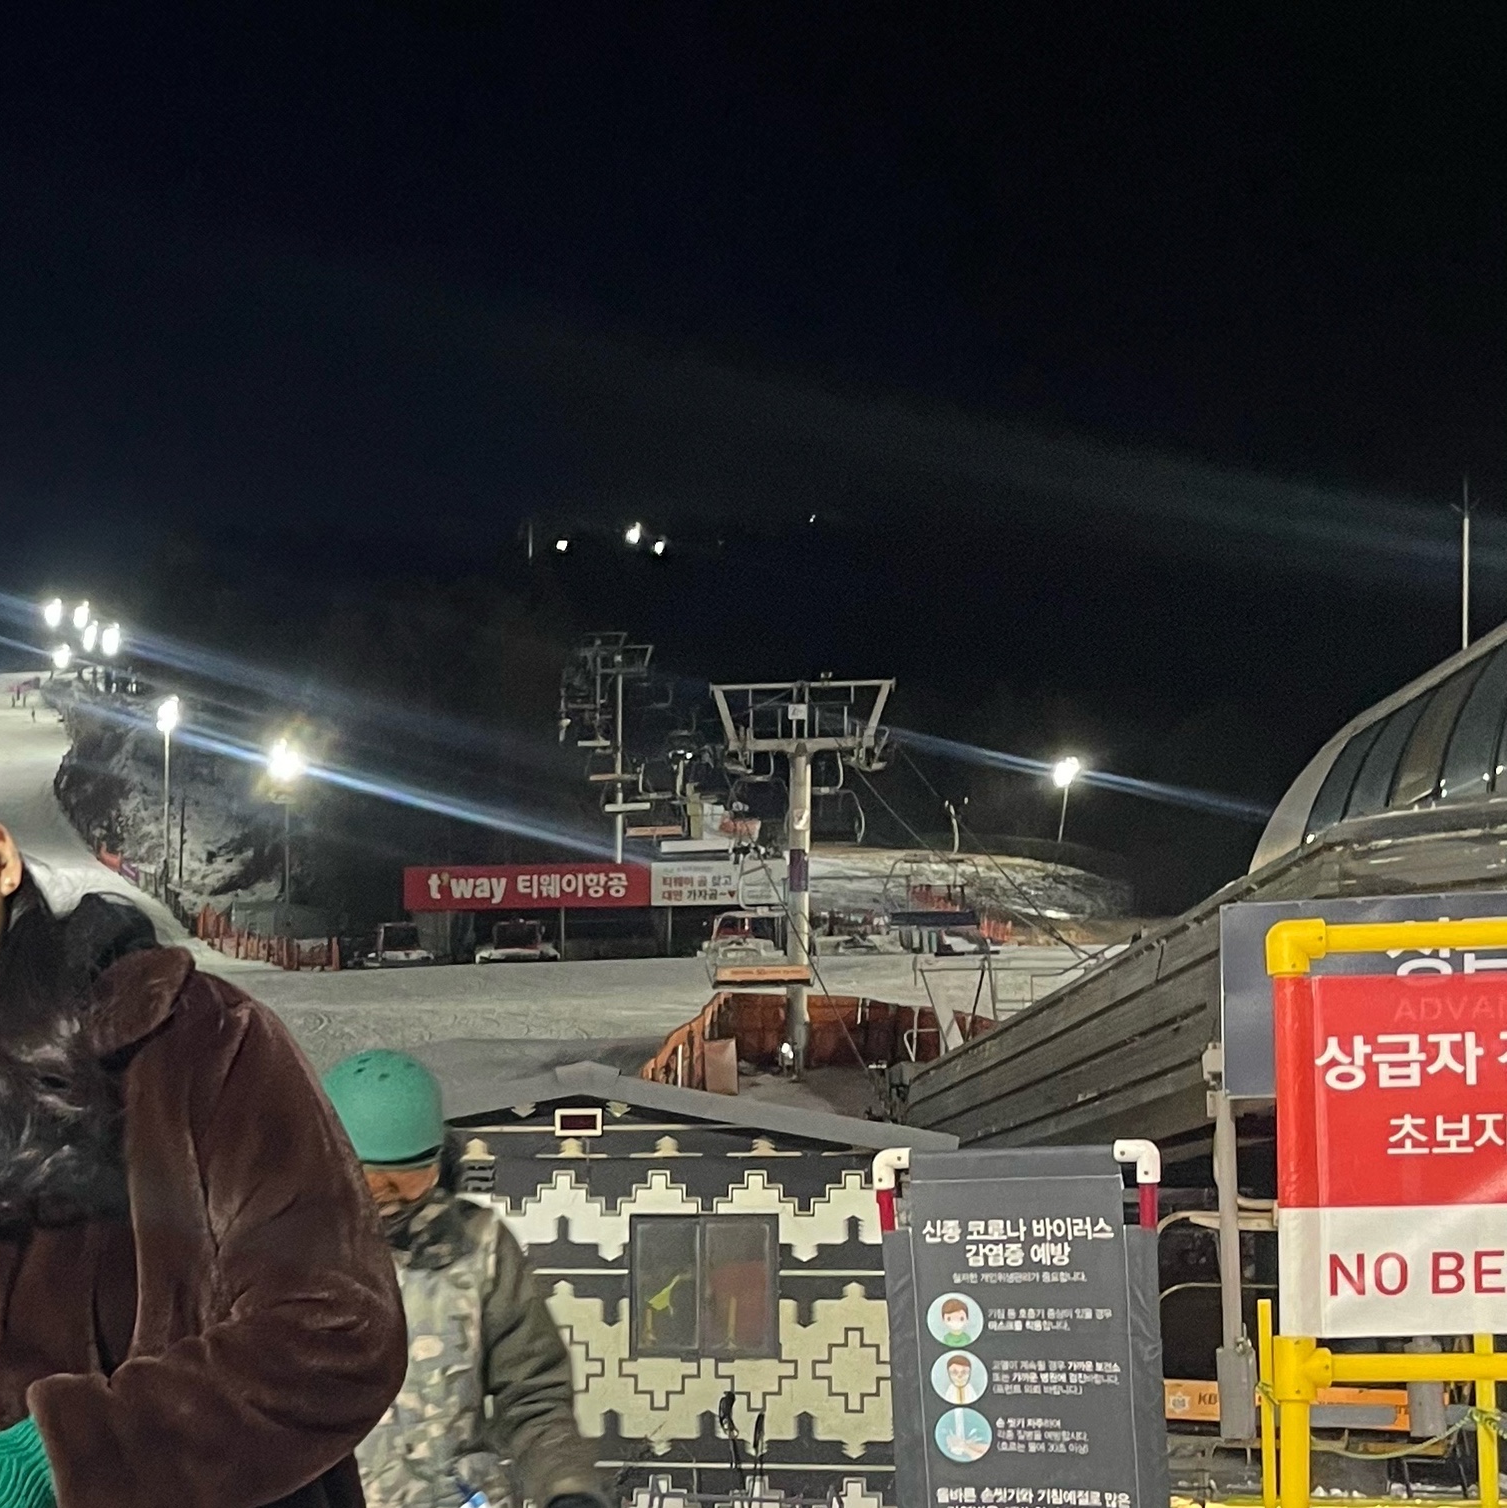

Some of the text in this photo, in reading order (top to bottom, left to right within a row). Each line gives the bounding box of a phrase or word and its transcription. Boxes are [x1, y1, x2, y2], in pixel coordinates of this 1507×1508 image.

[428, 871, 629, 905] t'way 티웨이항공
[1394, 994, 1507, 1022] ADVA
[1315, 1031, 1484, 1091] 상급자
[922, 1216, 1115, 1244] 신종 코로나 바이러스
[965, 1242, 1071, 1267] 감염증 예방
[1329, 1251, 1409, 1297] NO
[936, 1487, 976, 1503] 올바른
